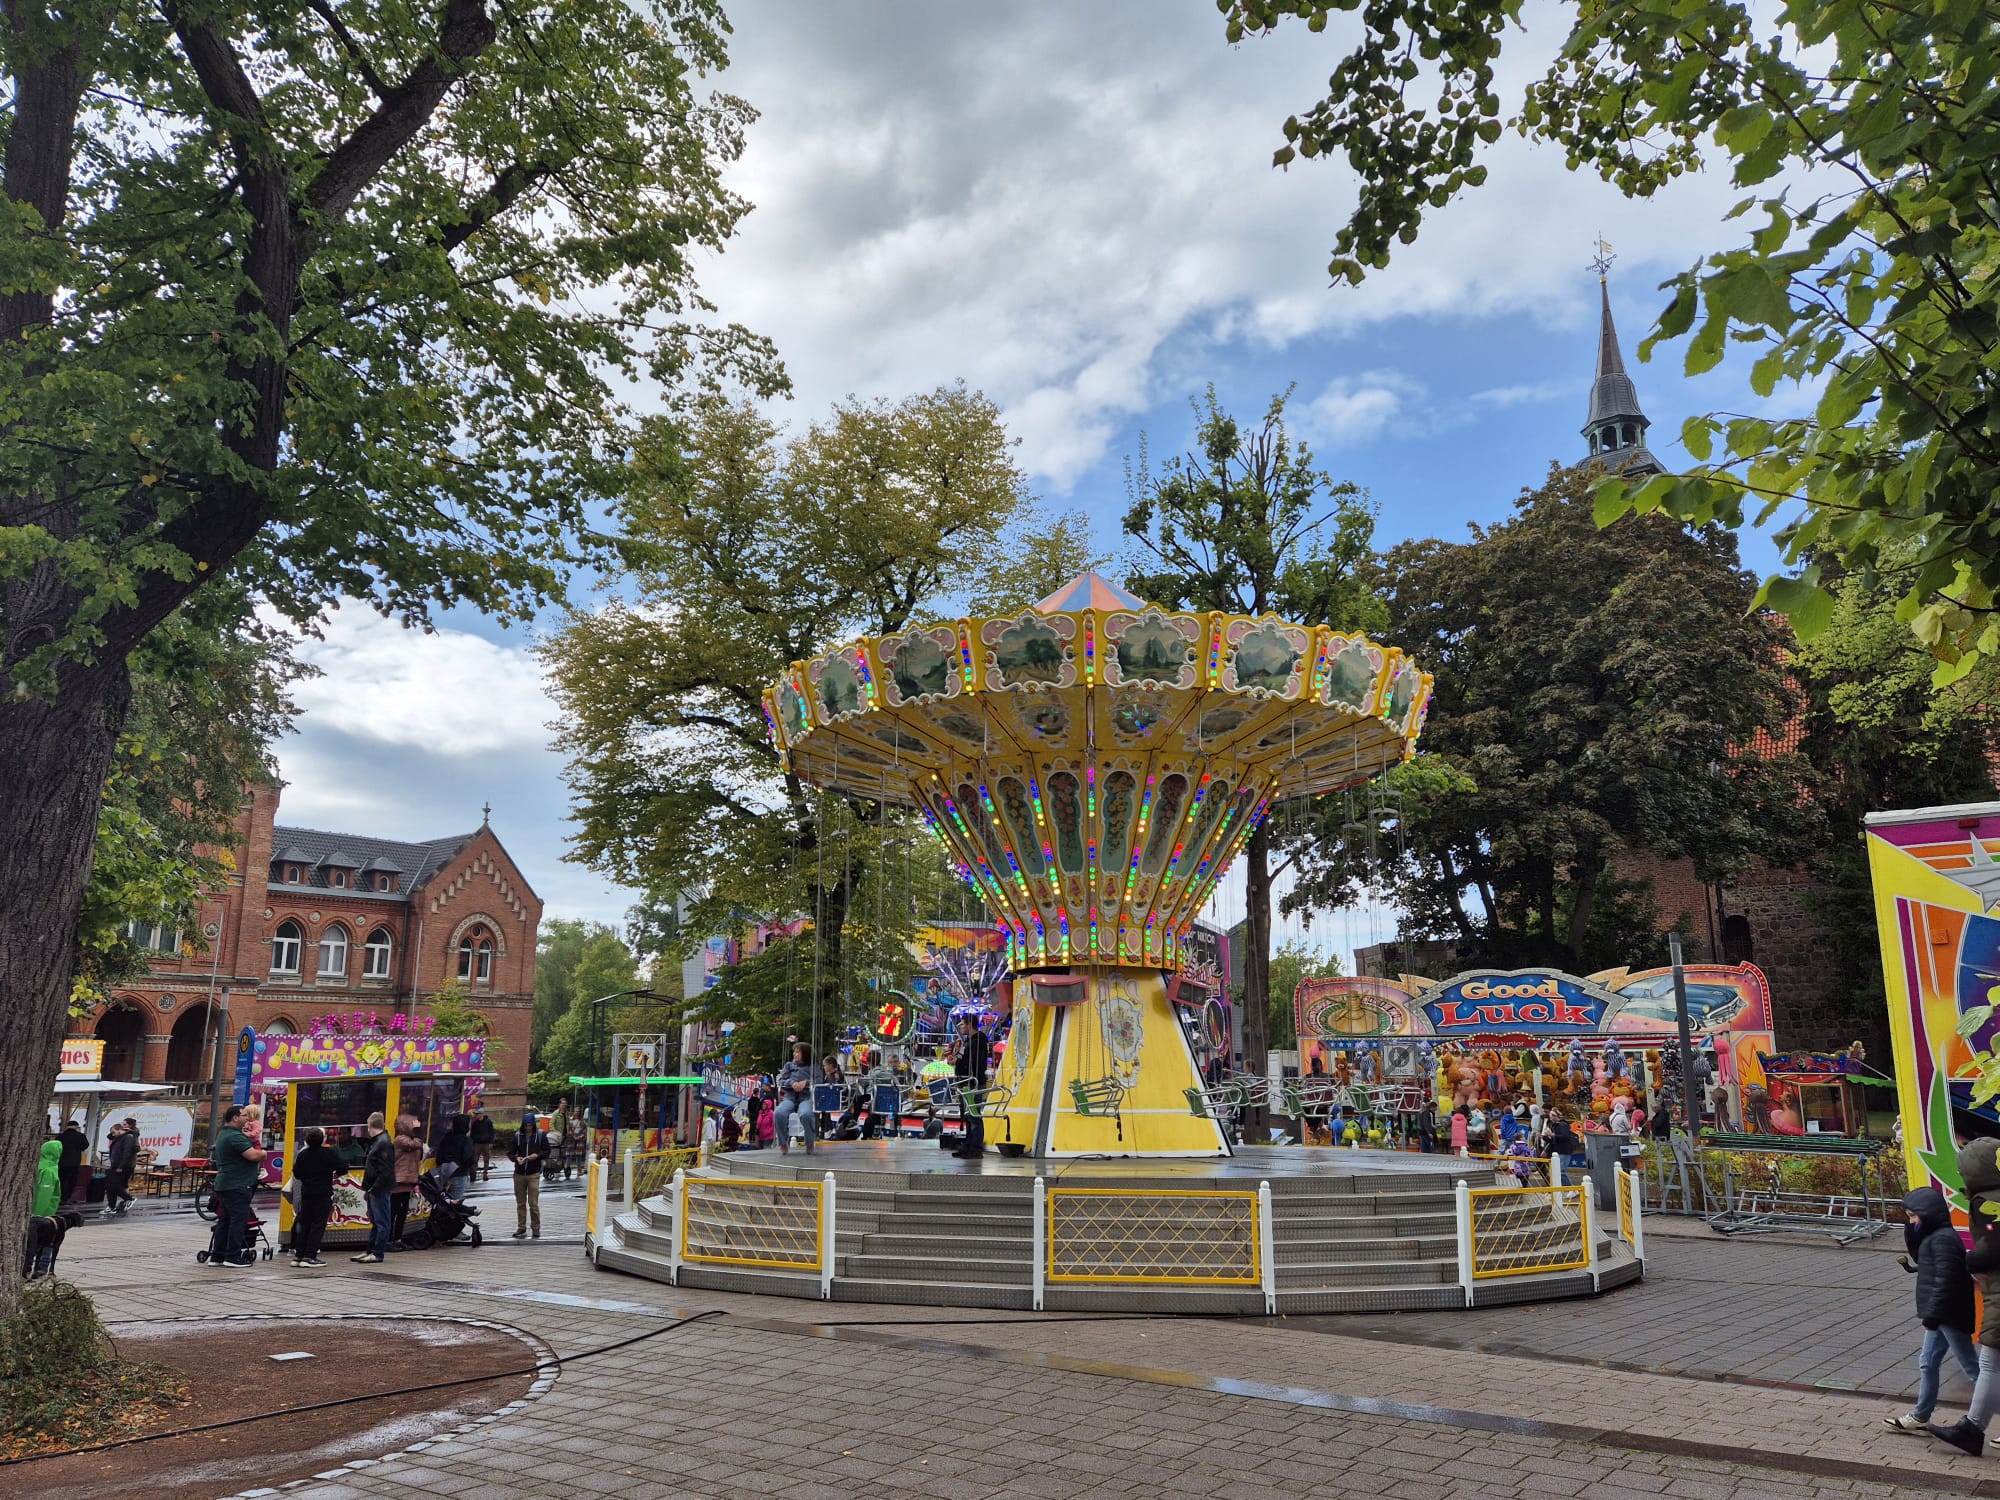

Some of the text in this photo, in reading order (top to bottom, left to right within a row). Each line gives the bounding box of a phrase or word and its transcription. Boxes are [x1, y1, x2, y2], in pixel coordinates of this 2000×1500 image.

[1460, 979, 1564, 999] Good
[1433, 998, 1596, 1027] Luck
[1501, 1040, 1525, 1048] junior
